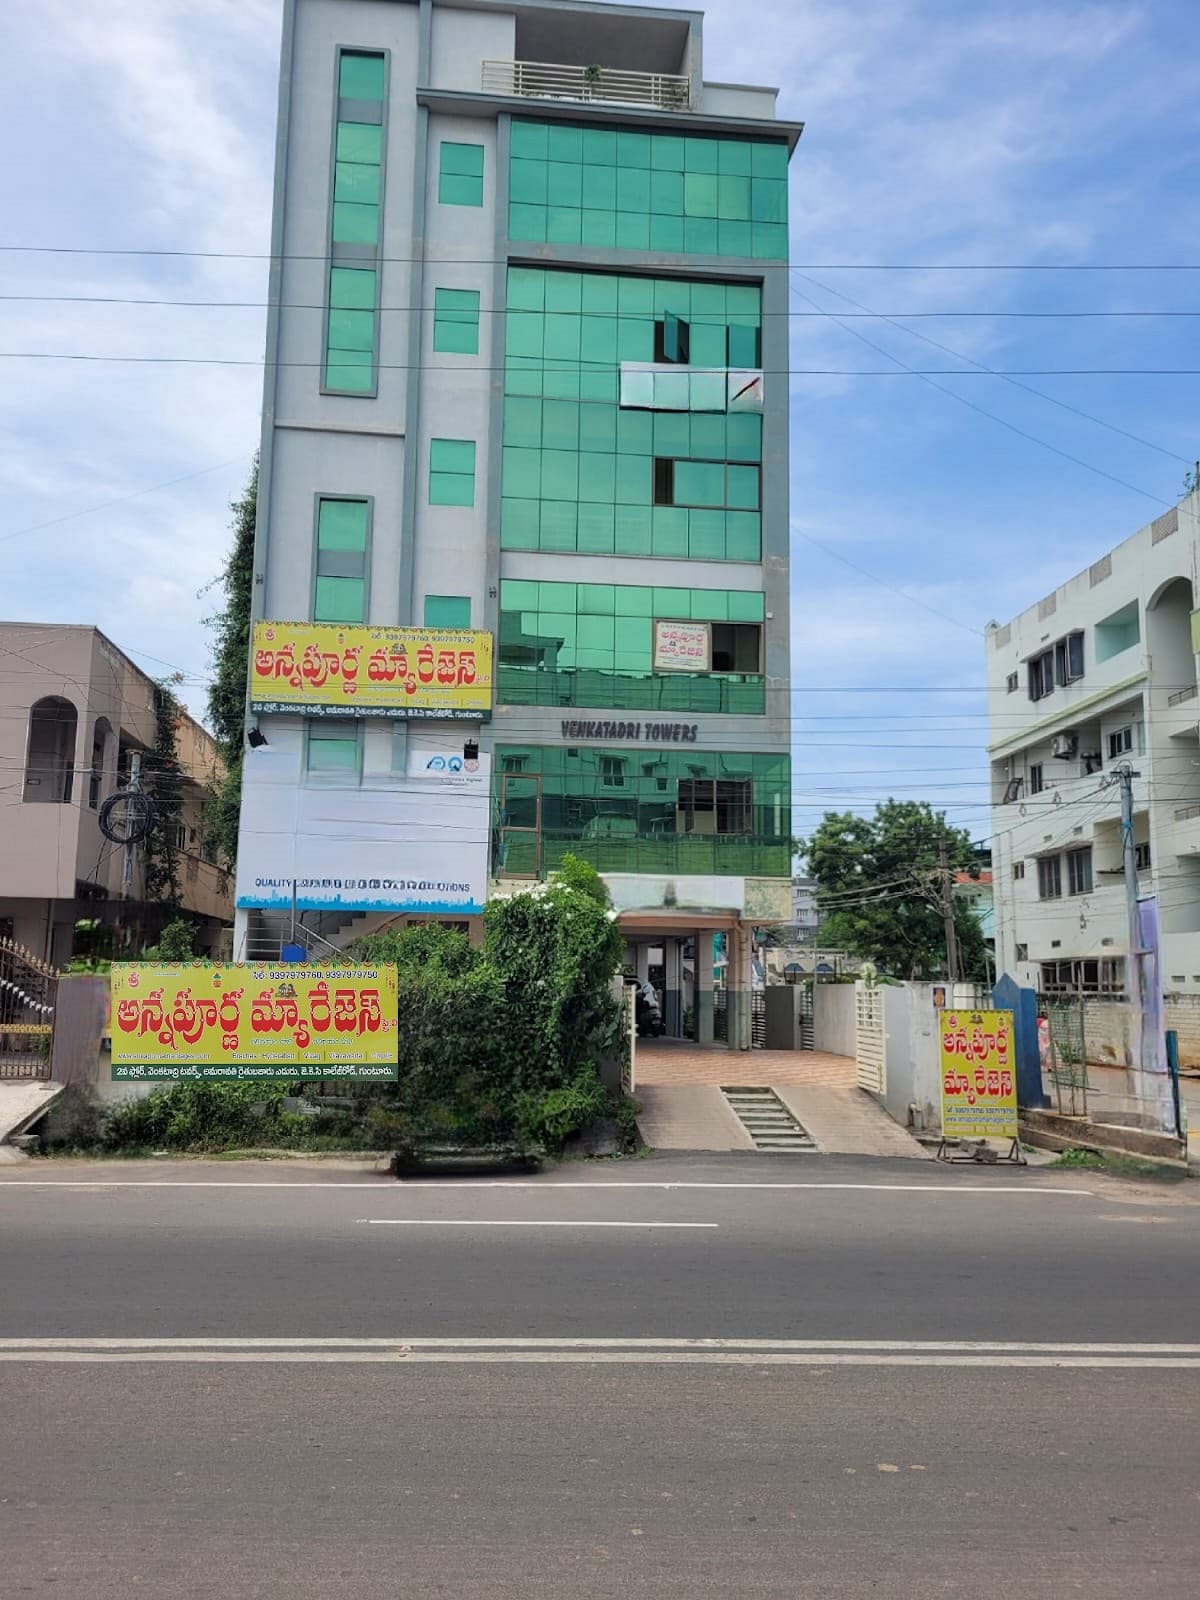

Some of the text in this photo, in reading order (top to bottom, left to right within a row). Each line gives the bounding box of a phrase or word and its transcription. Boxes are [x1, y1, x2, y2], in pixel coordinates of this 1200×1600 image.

[255, 643, 476, 694] అన్నపూర్ణ మ్యారేజెస్
[561, 720, 698, 741] VENKATADRI TOWERS
[255, 878, 292, 888] QUALITY
[117, 981, 382, 1051] అన్నపూర్ణ మ్యారేజెస్
[943, 1027, 1009, 1065] అన్నపూర్ణ
